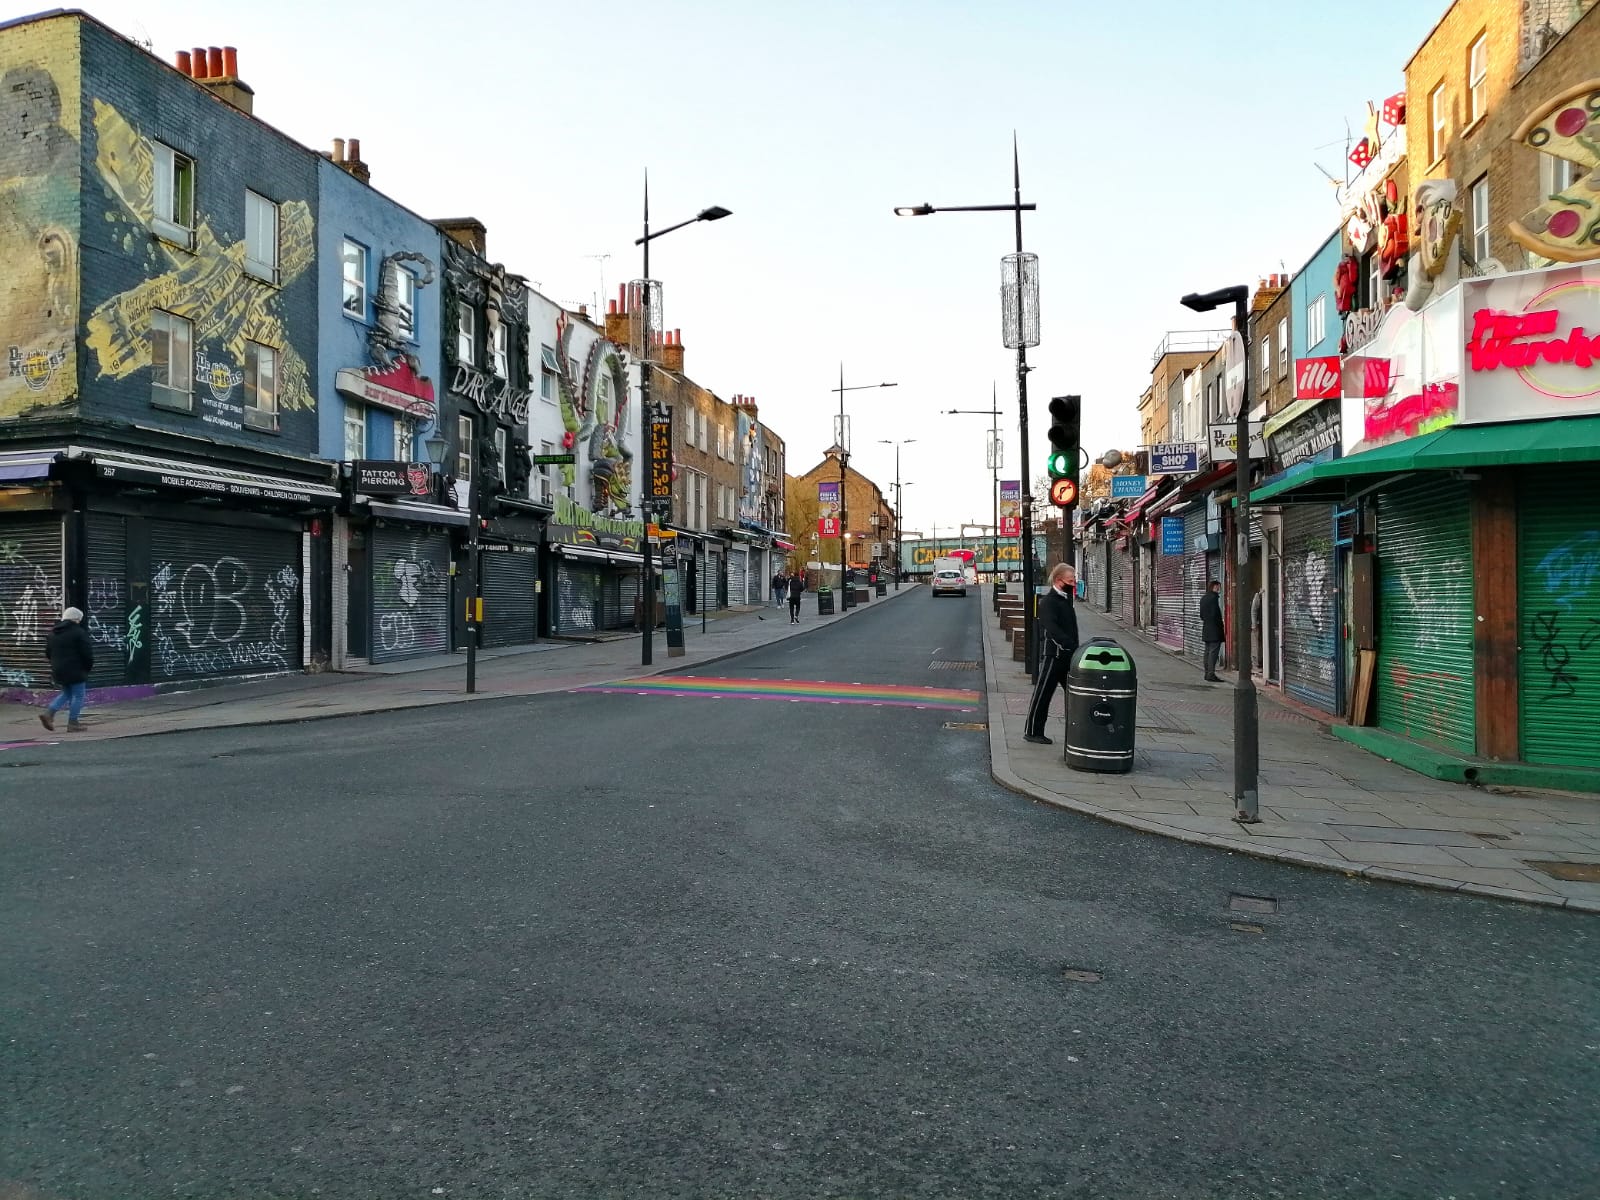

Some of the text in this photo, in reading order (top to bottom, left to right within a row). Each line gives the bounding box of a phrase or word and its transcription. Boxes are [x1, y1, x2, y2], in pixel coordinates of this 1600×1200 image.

[1299, 362, 1339, 396] illy
[1215, 431, 1263, 448] Marns
[1310, 424, 1341, 454] MARKET
[1152, 443, 1196, 456] LEATHER
[1161, 455, 1189, 466] SHOP
[361, 469, 396, 478] TATTOO
[161, 475, 185, 486] MOBILE
[185, 479, 226, 492] ACCESSORIES
[361, 477, 405, 486] PIERCING
